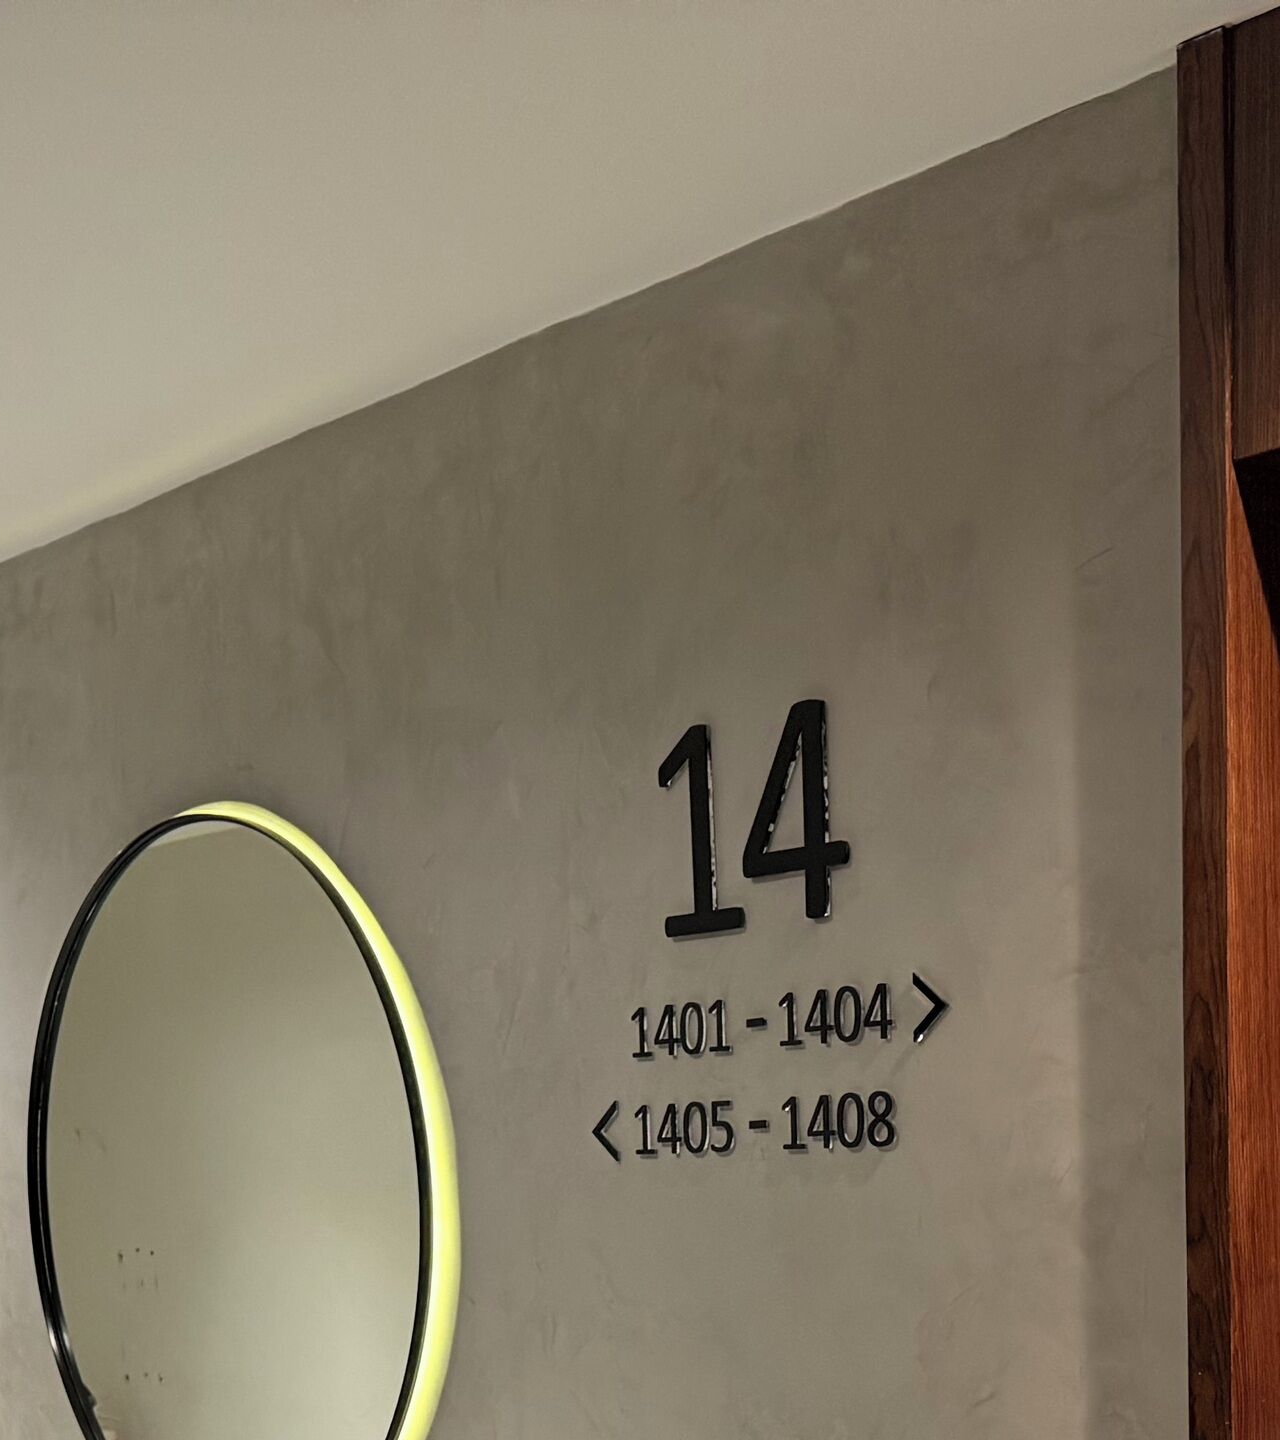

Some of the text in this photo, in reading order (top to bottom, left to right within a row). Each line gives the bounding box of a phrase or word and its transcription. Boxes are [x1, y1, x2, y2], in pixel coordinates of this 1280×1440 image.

[657, 698, 851, 938] 14
[630, 1000, 732, 1059] 1401
[777, 983, 895, 1047] 1404
[633, 1100, 736, 1155] 1405
[780, 1089, 897, 1152] 1408
